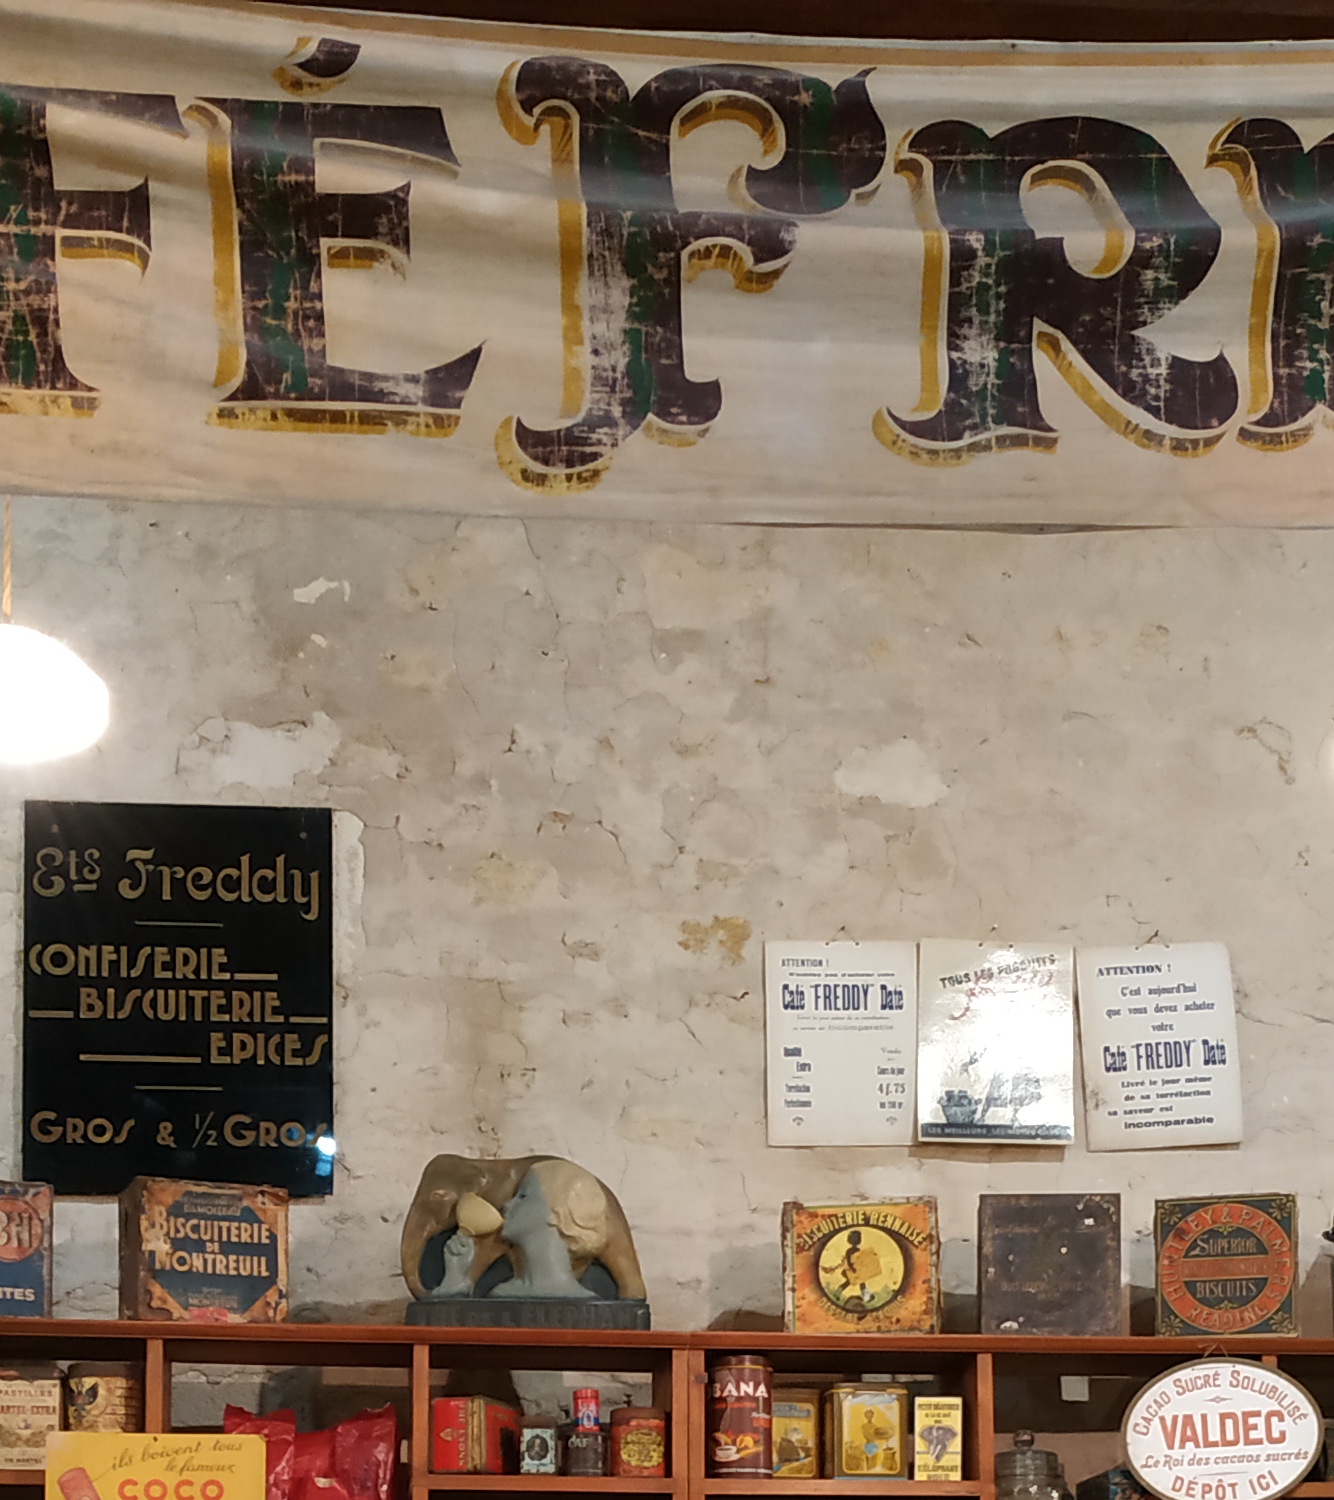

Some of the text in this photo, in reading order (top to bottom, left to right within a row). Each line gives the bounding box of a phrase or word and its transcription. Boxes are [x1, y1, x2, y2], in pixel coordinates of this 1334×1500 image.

[117, 845, 322, 921] Freddy
[28, 942, 233, 981] CONFISERIE
[1096, 964, 1163, 978] ATTENTION
[939, 972, 972, 990] TOUS
[79, 987, 285, 1023] BISCUITERIE
[1127, 1004, 1148, 1016] vous
[209, 1031, 330, 1066] EPICES
[1102, 1044, 1128, 1074] Café
[155, 1120, 178, 1149] &
[1123, 1115, 1215, 1130] incomparable
[153, 1205, 271, 1244] BISCUITERIE
[869, 1210, 927, 1247] RENNAISE
[205, 1241, 221, 1253] DE
[1160, 1206, 1291, 1301] HUNTLEY & PALMERS
[1195, 1279, 1257, 1299] BISCUITS
[1132, 1369, 1310, 1438] CACAO SUCRÉ SOLUBILISÉ
[1158, 1408, 1288, 1451] VALDEC
[211, 1438, 244, 1453] tous
[1140, 1449, 1310, 1471] Le Roi des cacaos sucrés
[1247, 1468, 1280, 1496] ICI
